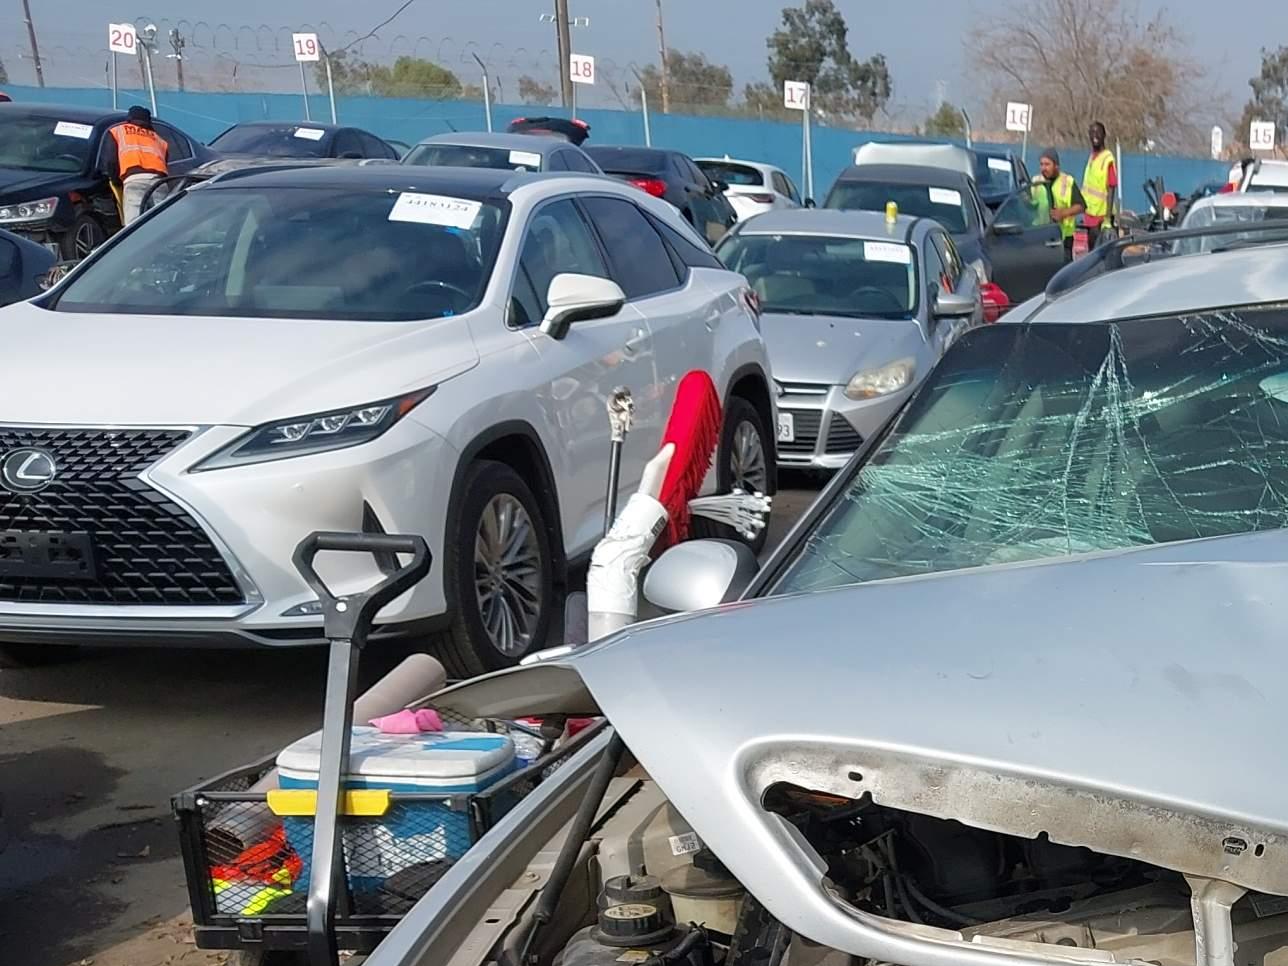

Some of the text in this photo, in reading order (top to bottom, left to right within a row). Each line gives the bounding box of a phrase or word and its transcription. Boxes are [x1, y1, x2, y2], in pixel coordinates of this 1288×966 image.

[111, 29, 134, 49] 20
[295, 39, 316, 57] 19
[572, 61, 592, 78] 18
[786, 87, 807, 104] 17
[1252, 129, 1272, 144] 15
